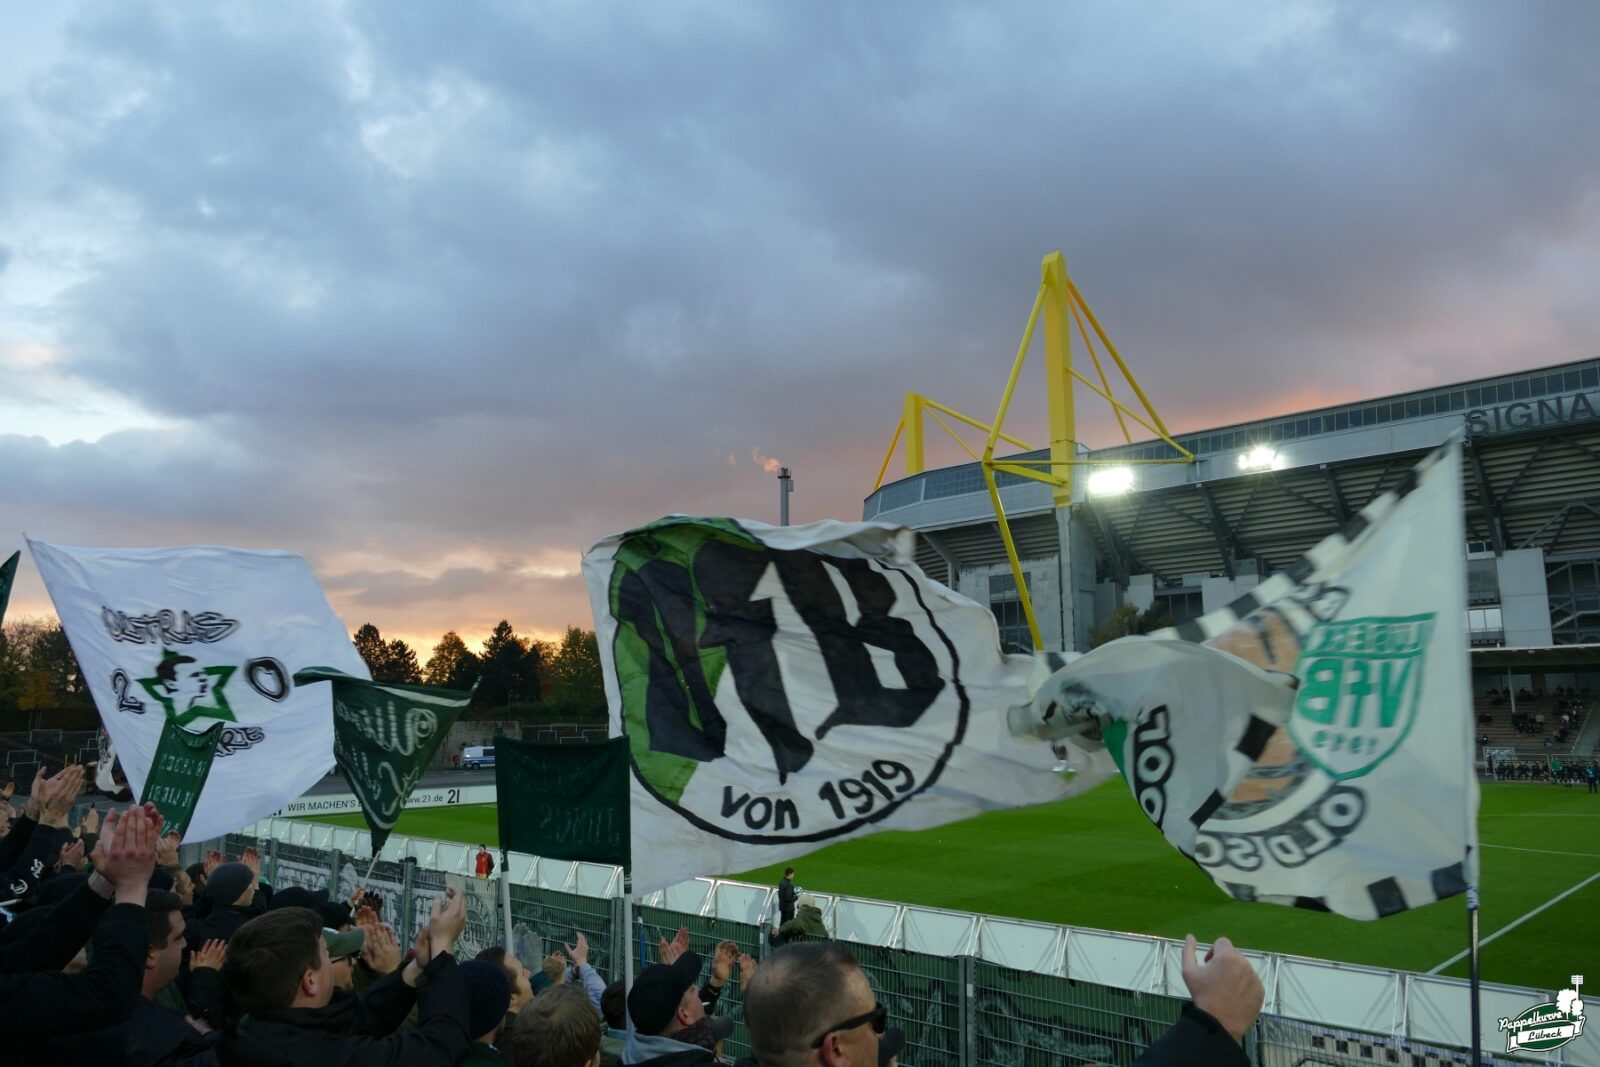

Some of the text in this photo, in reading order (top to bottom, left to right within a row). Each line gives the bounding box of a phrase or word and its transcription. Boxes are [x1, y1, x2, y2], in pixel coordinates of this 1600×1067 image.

[448, 789, 460, 804] 21
[818, 760, 915, 820] 1919
[288, 803, 306, 812] WIR
[308, 800, 356, 811] MACHEN'S
